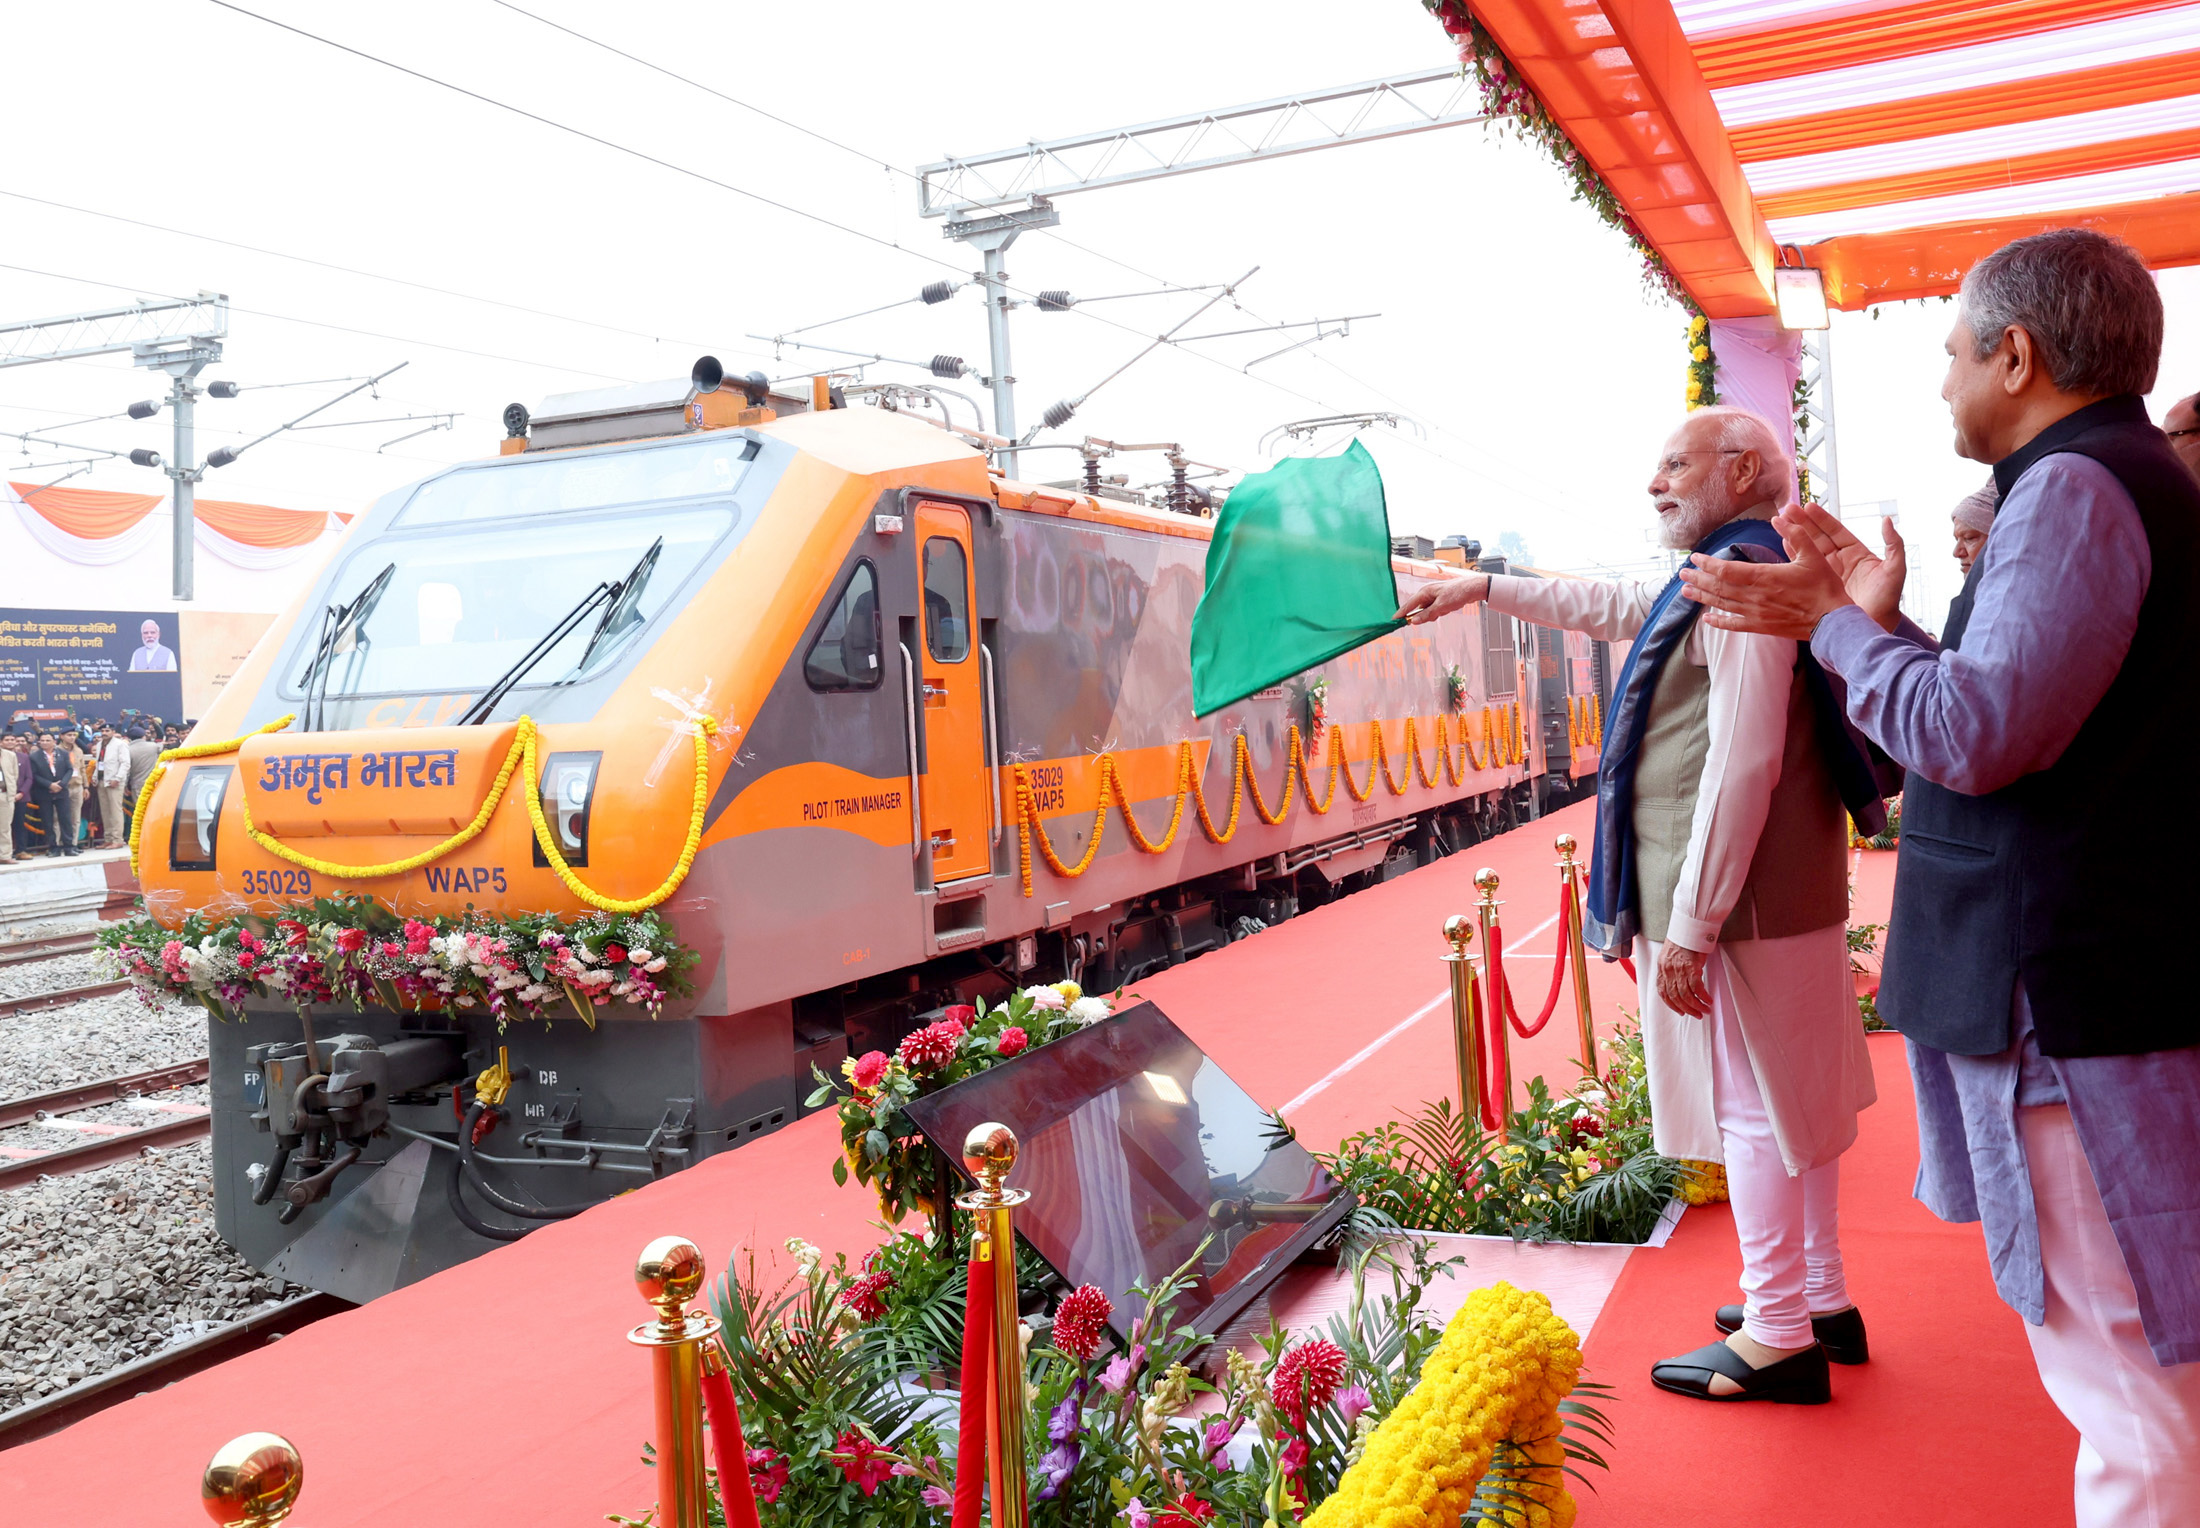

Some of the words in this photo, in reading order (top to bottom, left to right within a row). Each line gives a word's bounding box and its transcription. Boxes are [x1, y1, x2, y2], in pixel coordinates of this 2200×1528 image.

[22, 636, 46, 647] करती
[47, 638, 68, 648] भारत
[69, 636, 80, 648] की
[81, 636, 103, 648] प्रगति
[259, 753, 352, 805] अमृत
[360, 749, 459, 788] भारत
[1031, 766, 1064, 790] 35029
[803, 801, 828, 821] PILOT
[835, 797, 860, 817] TRAIN
[861, 792, 902, 813] MANAGER
[241, 869, 312, 895] 35029
[424, 866, 508, 894] WAP5
[842, 947, 871, 966] CAB-1
[244, 1072, 260, 1086] FP
